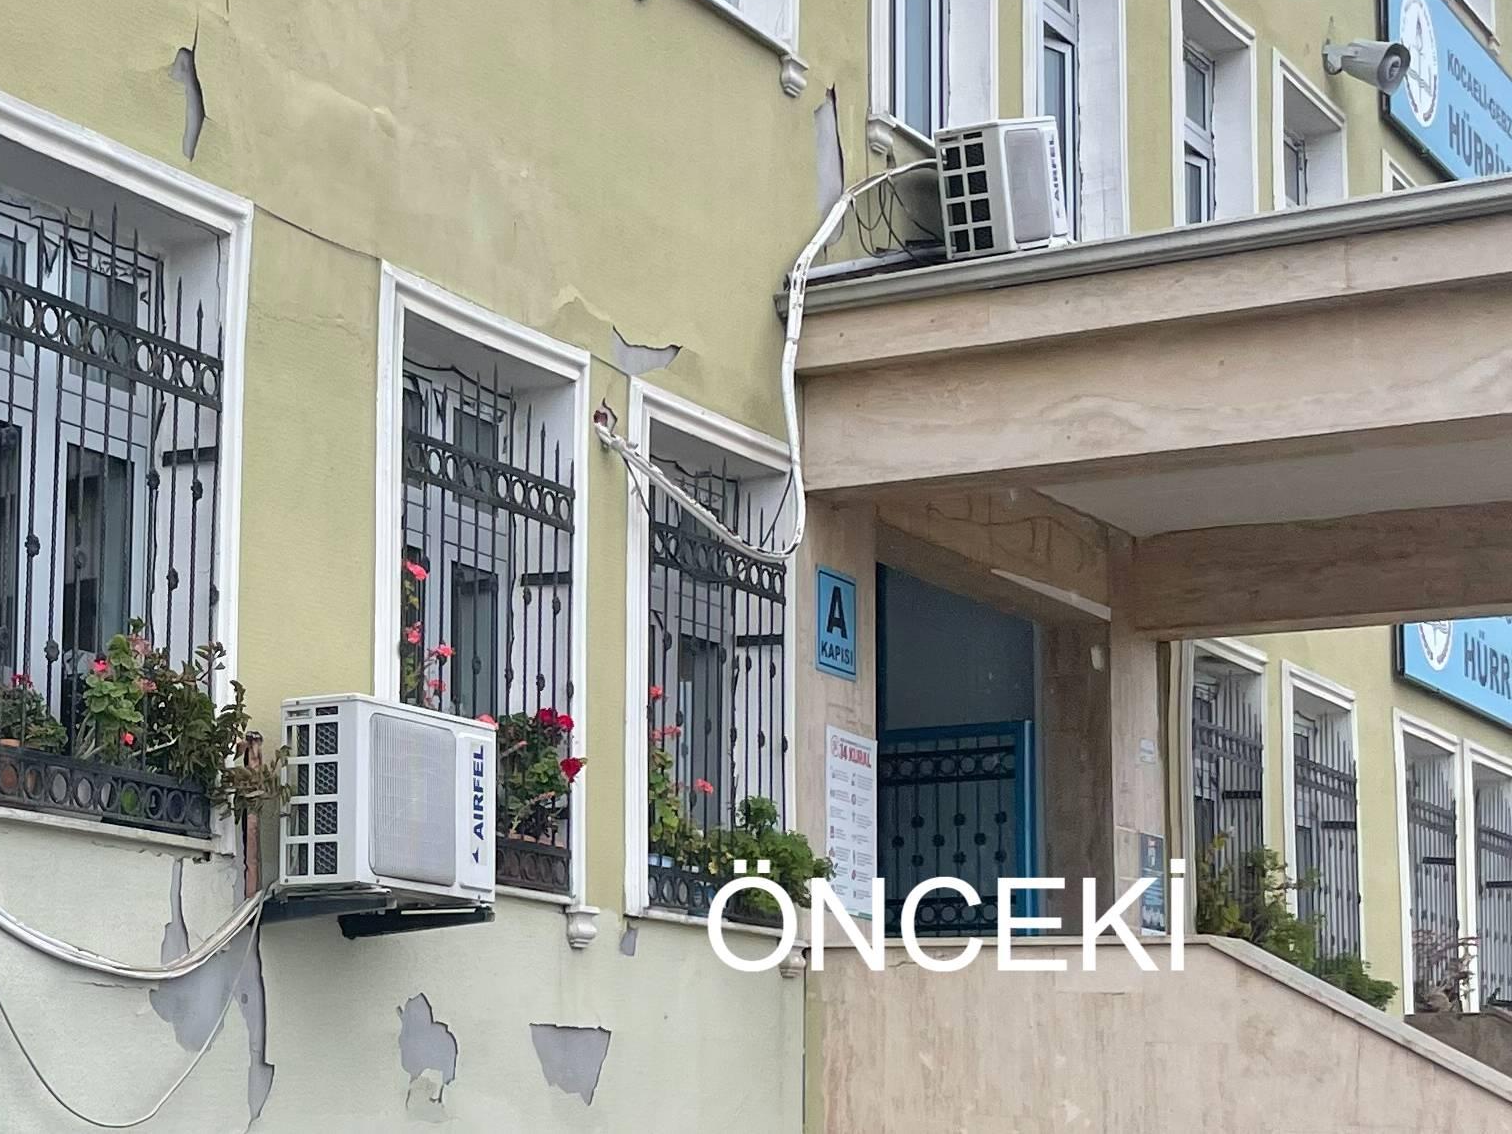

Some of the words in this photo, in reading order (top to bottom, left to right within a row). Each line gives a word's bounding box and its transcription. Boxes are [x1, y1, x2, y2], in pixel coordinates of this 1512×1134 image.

[826, 585, 849, 640] A
[821, 640, 853, 666] KAPISI
[472, 745, 485, 841] AIRFEL
